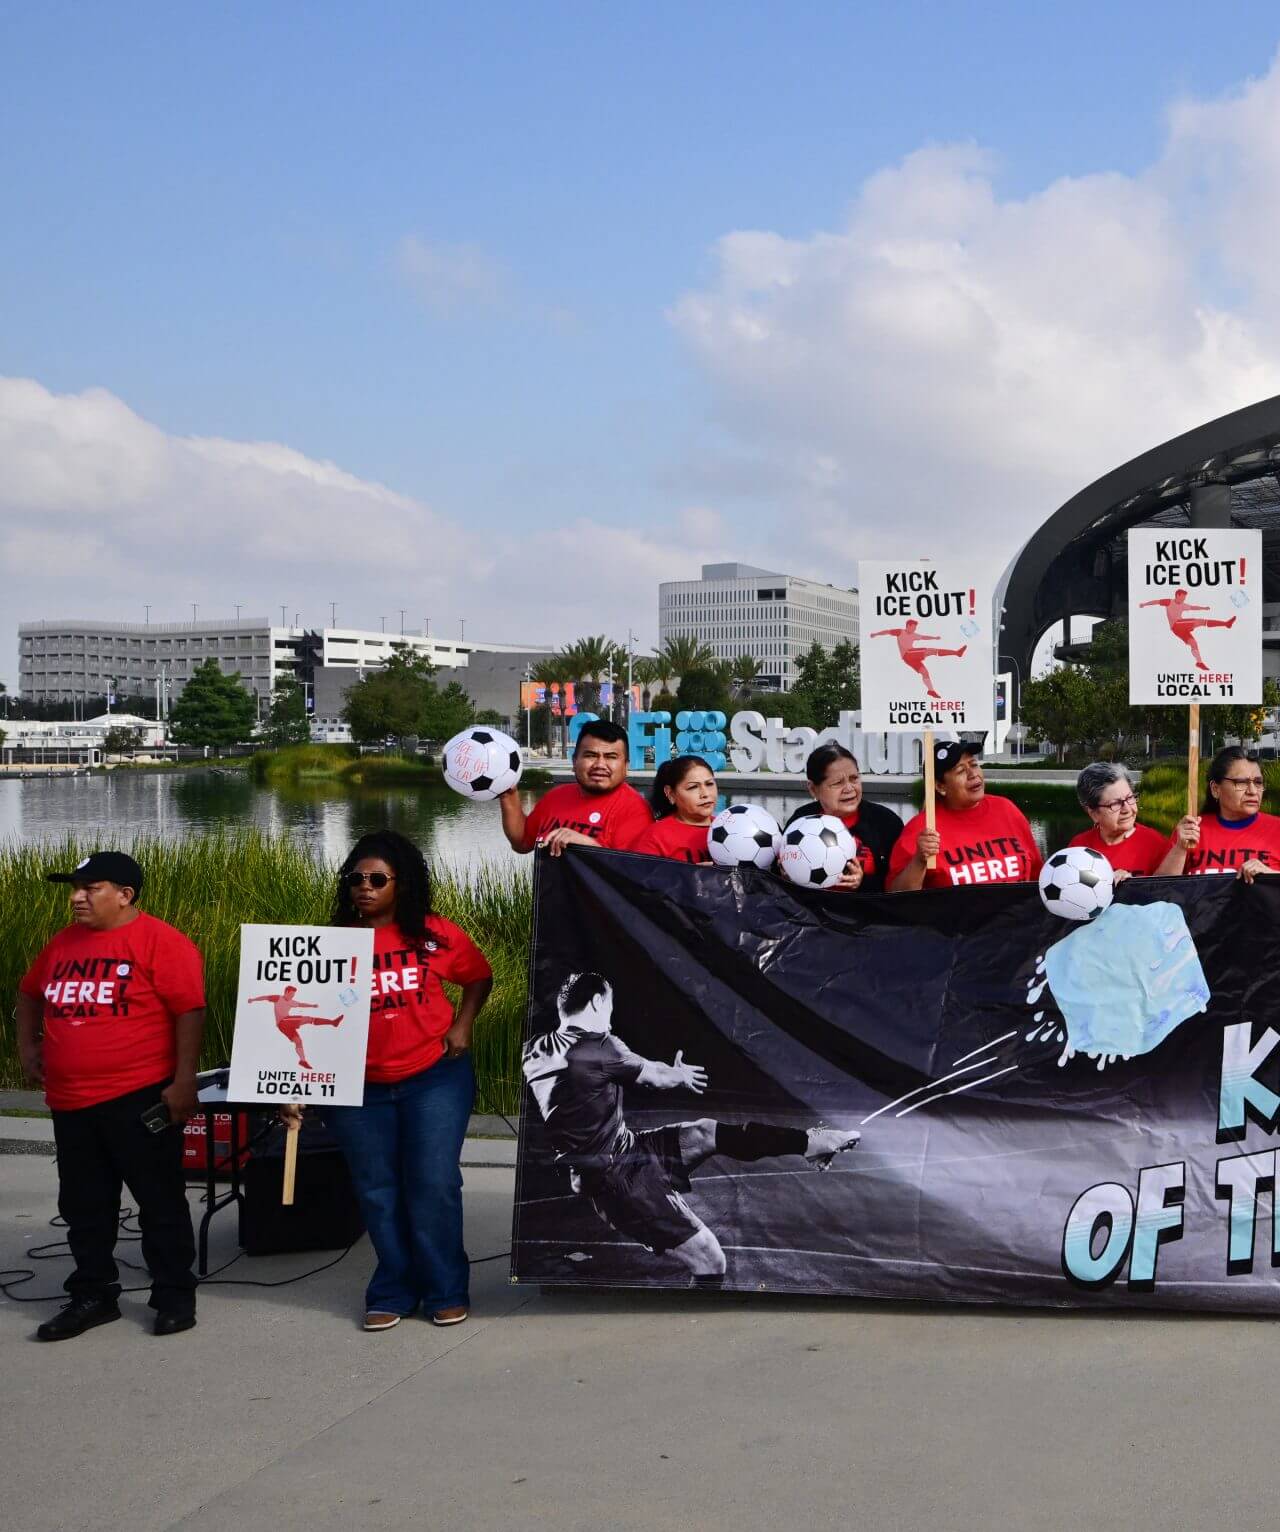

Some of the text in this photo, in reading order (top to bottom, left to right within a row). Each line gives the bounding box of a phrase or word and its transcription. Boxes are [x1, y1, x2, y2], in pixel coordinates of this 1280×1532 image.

[1156, 538, 1209, 561] KICK
[886, 570, 938, 593] KICK
[1146, 558, 1246, 587] ICE OUT!
[876, 589, 976, 617] ICE OUT!
[1157, 673, 1233, 683] UNITE HERE!
[1158, 684, 1233, 696] LOCAL 11
[889, 701, 965, 711] UNITE HERE!
[889, 712, 965, 724] LOCAL 11
[944, 837, 1025, 866] UNITE
[270, 936, 321, 957] KICK
[256, 956, 358, 984] ICE OUT!
[370, 967, 428, 997] ERE!
[258, 1070, 336, 1083] UNITE HERE!
[256, 1082, 335, 1097] LOCAL 11
[1061, 1161, 1186, 1293] OF
